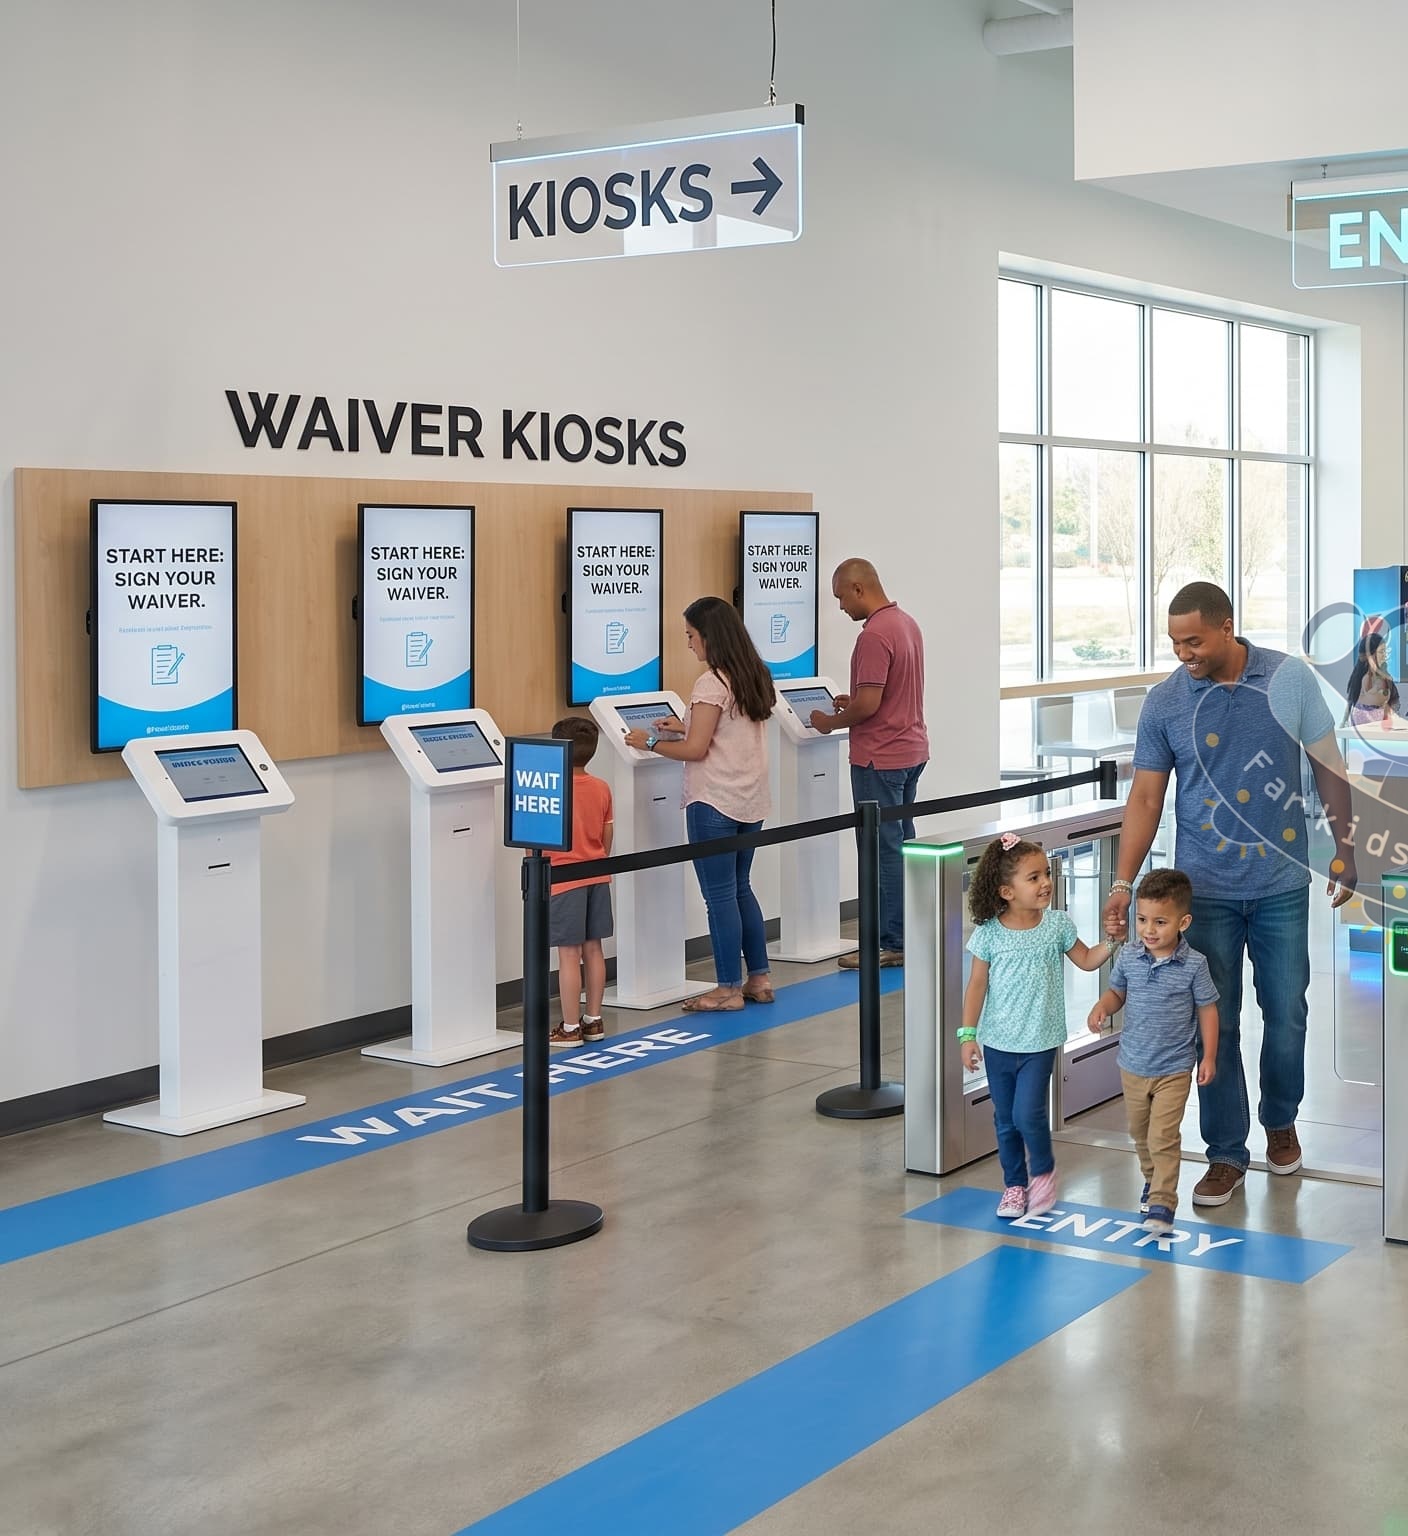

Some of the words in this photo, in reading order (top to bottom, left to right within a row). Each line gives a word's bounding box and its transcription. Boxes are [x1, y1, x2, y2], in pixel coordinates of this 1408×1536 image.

[508, 162, 714, 241] KIOSKS
[224, 389, 485, 458] WAIVER
[501, 408, 688, 467] KIOSKS
[106, 548, 167, 564] START
[171, 548, 224, 563] HERE:
[370, 546, 419, 561] START
[422, 546, 465, 560] HERE:
[576, 545, 617, 558] START
[620, 545, 656, 558] HERE:
[747, 545, 781, 556] START
[783, 545, 813, 556] HERE:
[376, 567, 413, 581] SIGN
[416, 566, 458, 580] YOUR
[582, 564, 613, 577] SIGN
[616, 564, 650, 576] YOUR
[751, 561, 777, 573] SIGN
[779, 561, 808, 573] YOUR
[114, 571, 160, 587] SIGN
[164, 570, 216, 586] YOUR
[758, 577, 802, 590] WAIVER.
[387, 586, 449, 601] WAIVER.
[590, 582, 643, 595] WAIVER.
[127, 593, 206, 610] WAIVER.
[515, 769, 561, 790] WAIT
[514, 794, 561, 815] HERE
[295, 1082, 519, 1146] WAIT
